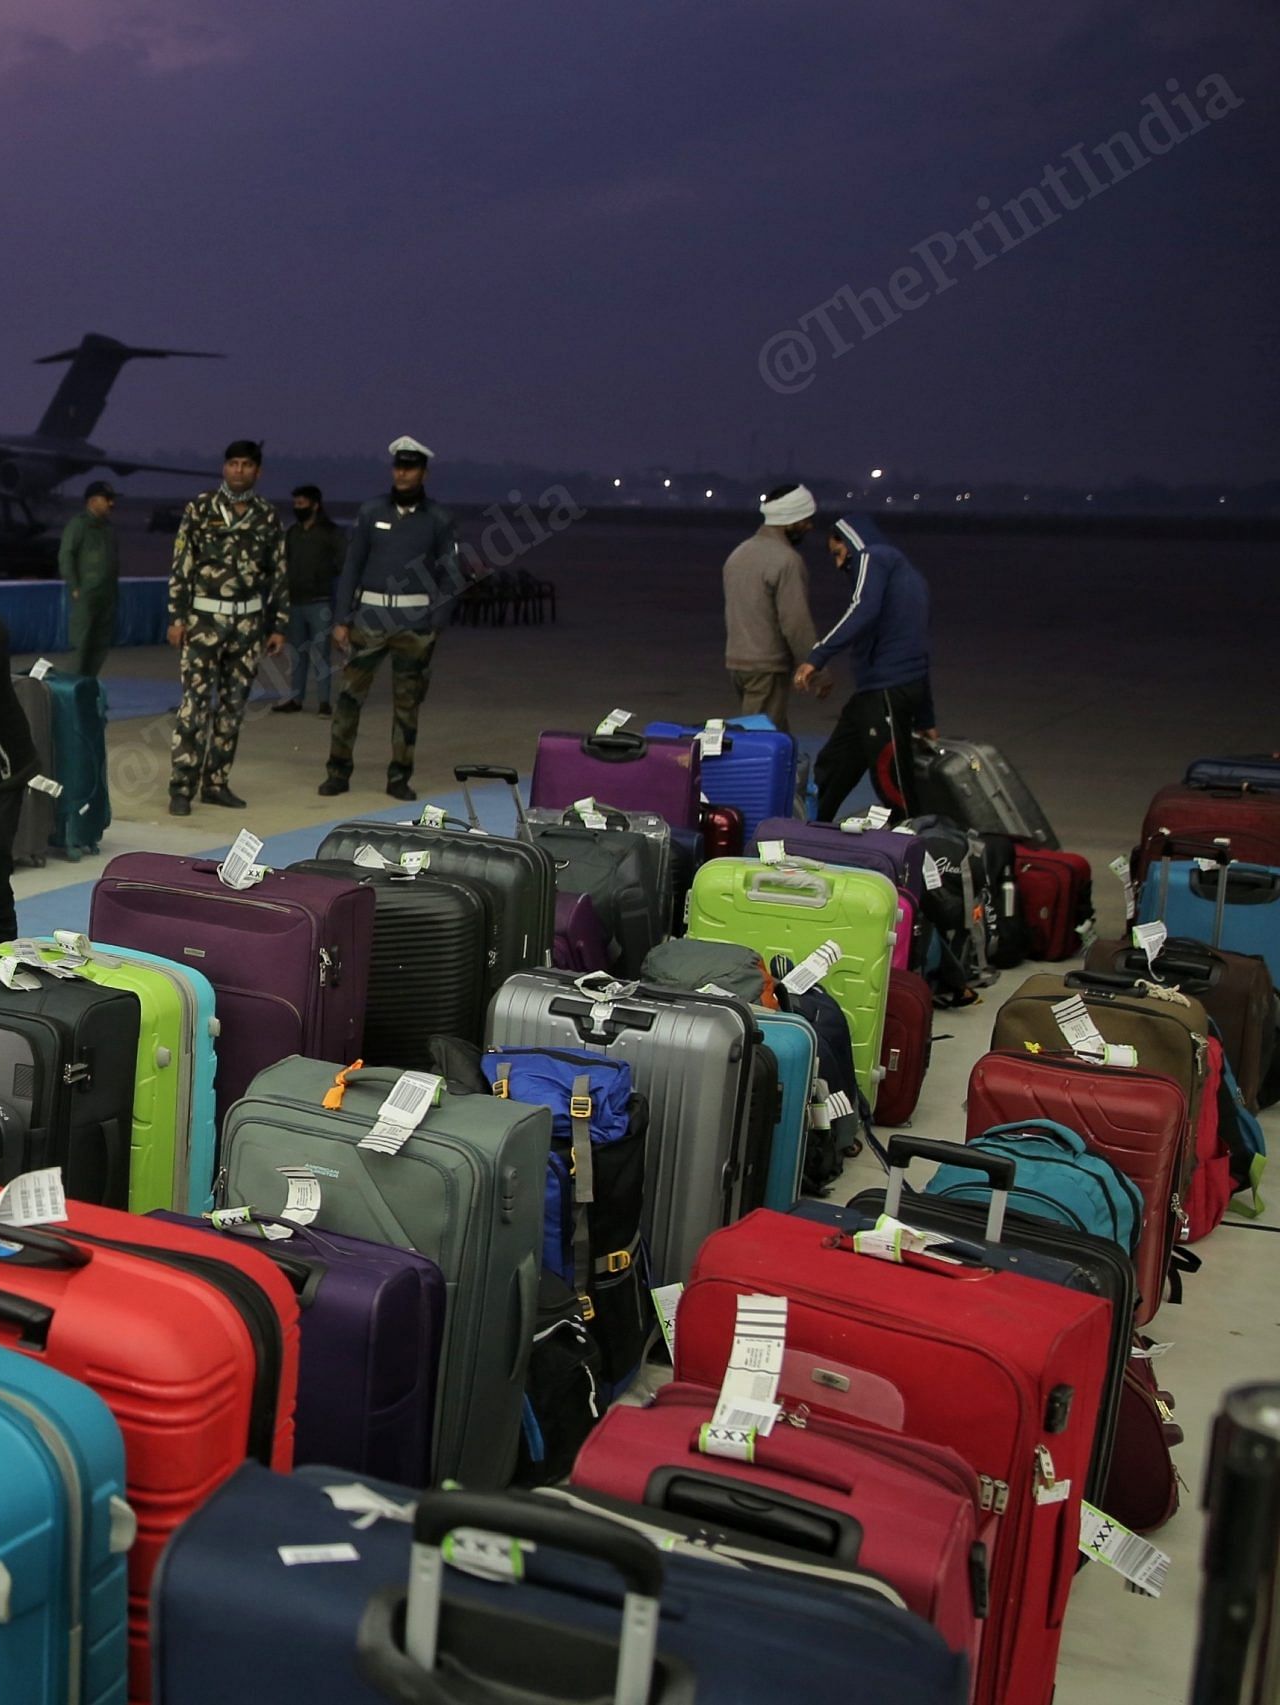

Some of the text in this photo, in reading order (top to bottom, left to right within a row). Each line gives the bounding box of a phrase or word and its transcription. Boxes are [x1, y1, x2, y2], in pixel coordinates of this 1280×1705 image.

[219, 1215, 248, 1227] XXX
[708, 1428, 752, 1444] XXX
[1090, 1520, 1115, 1552] XXX
